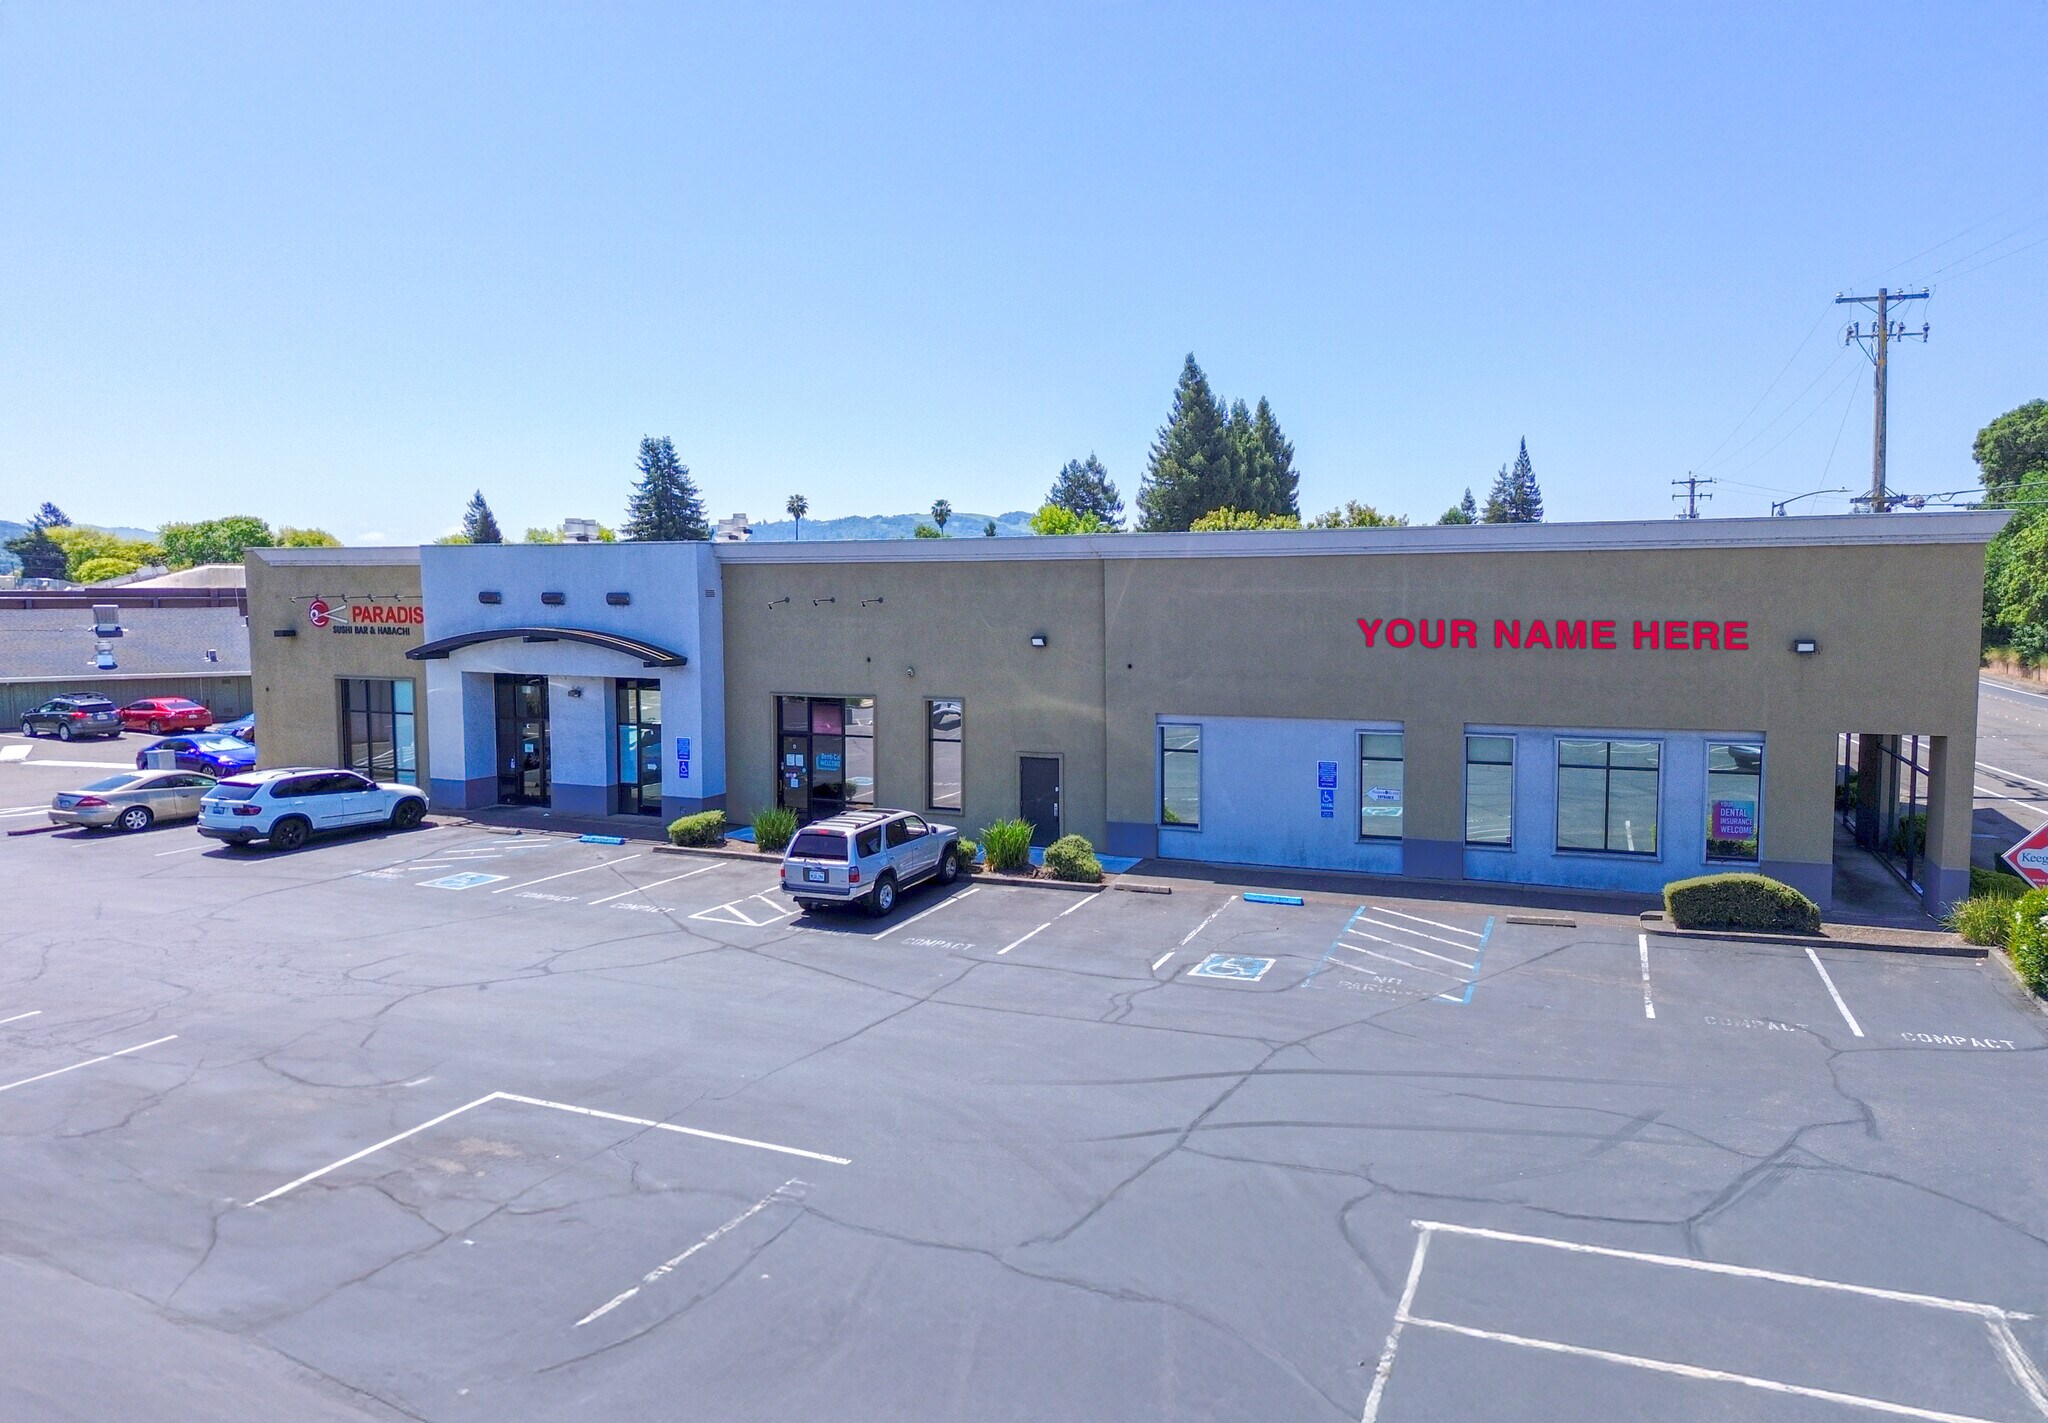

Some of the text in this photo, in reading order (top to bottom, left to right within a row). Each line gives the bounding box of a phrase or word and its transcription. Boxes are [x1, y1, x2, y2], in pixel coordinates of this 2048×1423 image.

[352, 605, 424, 624] PARADIS
[332, 625, 410, 636] SUSHI BAR & HABACHI
[1720, 808, 1747, 817] DENTAL
[1720, 817, 1753, 826] INSURANCE
[1720, 825, 1753, 834] WELCOME
[515, 891, 579, 902] COMPACT
[609, 902, 676, 913] COMPACT
[901, 937, 976, 951] COMPACT
[1703, 1015, 1809, 1033] COMPACT
[1900, 1031, 2016, 1050] COMPACT
